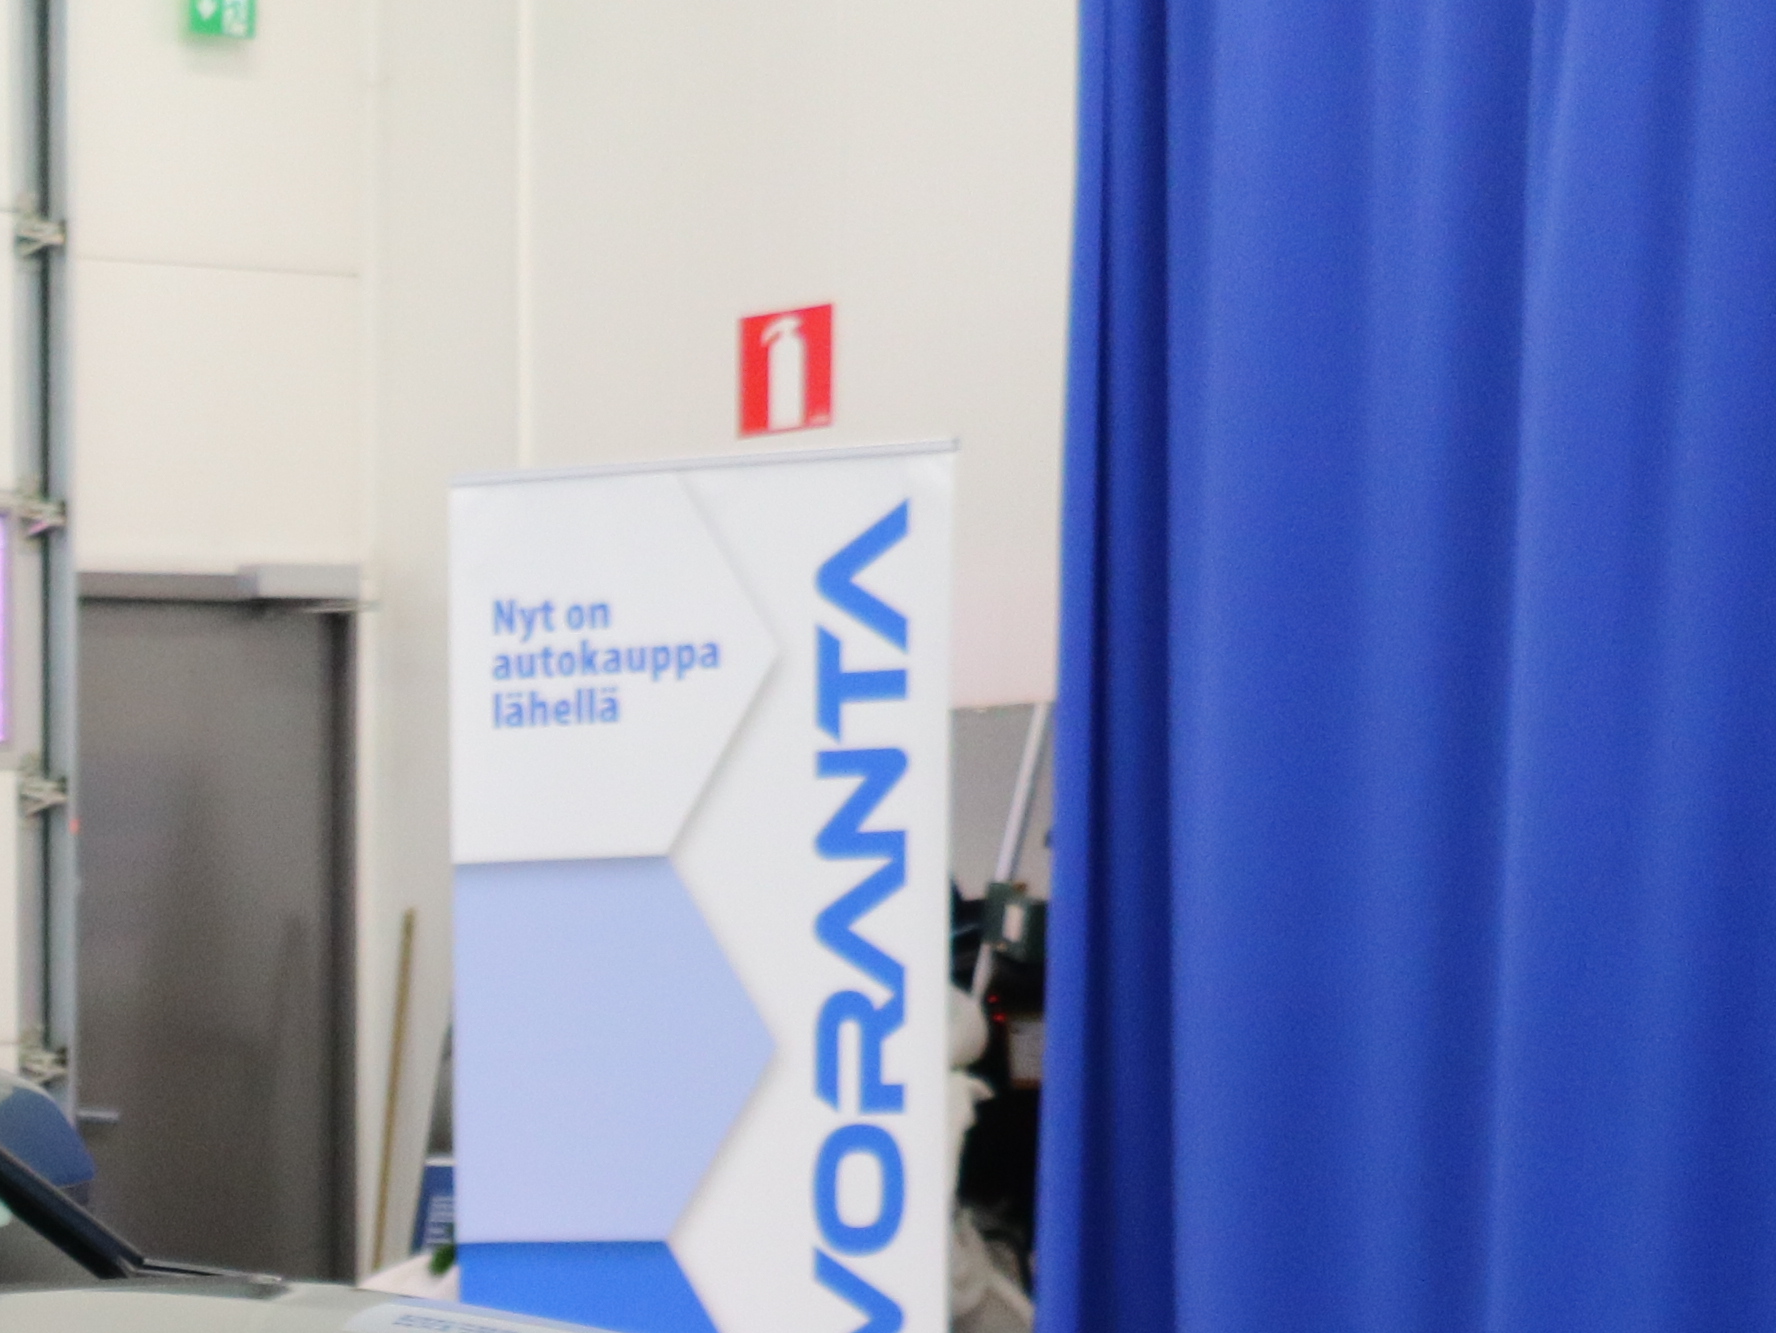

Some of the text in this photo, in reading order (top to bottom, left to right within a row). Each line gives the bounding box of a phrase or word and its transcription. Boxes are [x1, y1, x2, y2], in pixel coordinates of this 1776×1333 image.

[493, 600, 610, 639] Nyt on
[493, 640, 720, 681] autokauppa
[494, 687, 620, 728] lähellä
